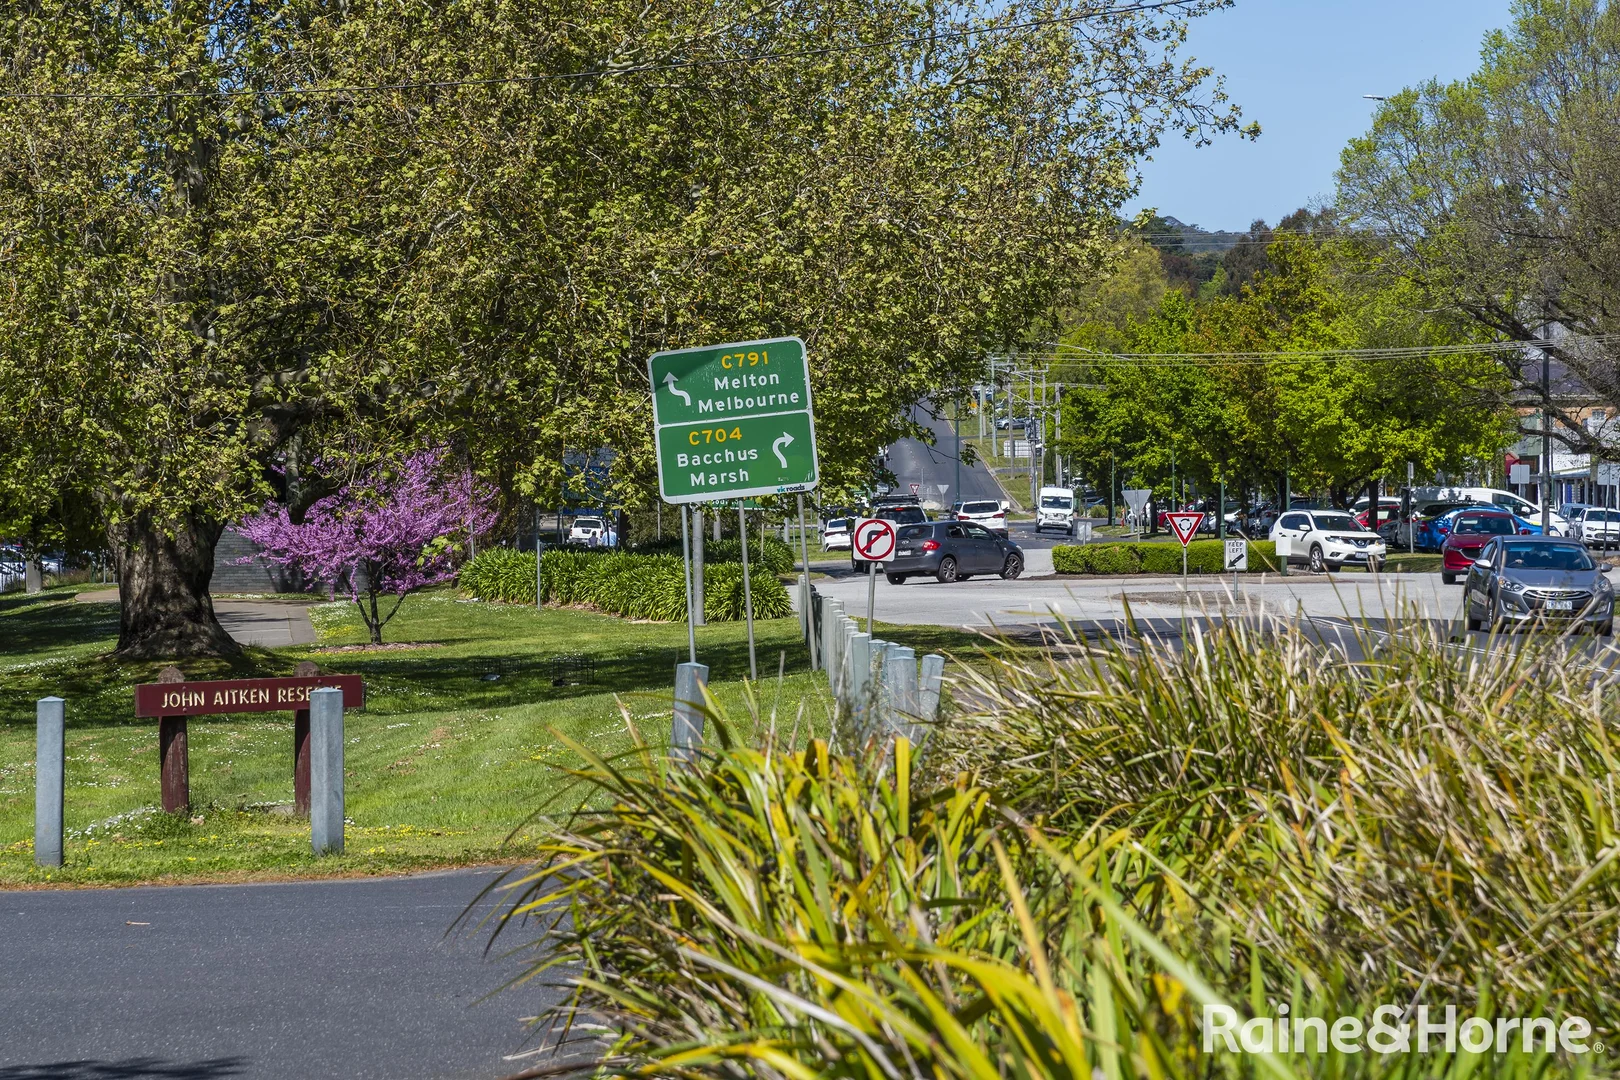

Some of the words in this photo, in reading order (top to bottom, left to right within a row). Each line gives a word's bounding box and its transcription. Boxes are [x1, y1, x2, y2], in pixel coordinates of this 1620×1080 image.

[721, 351, 769, 369] C791
[714, 373, 780, 391] Melton
[698, 392, 800, 413] Melbourne
[688, 427, 743, 446] C704
[677, 449, 758, 467] Bacchus
[690, 469, 749, 487] Marsh
[161, 692, 205, 709] JOHN
[213, 688, 270, 706] AITKEN
[277, 685, 342, 703] RESE
